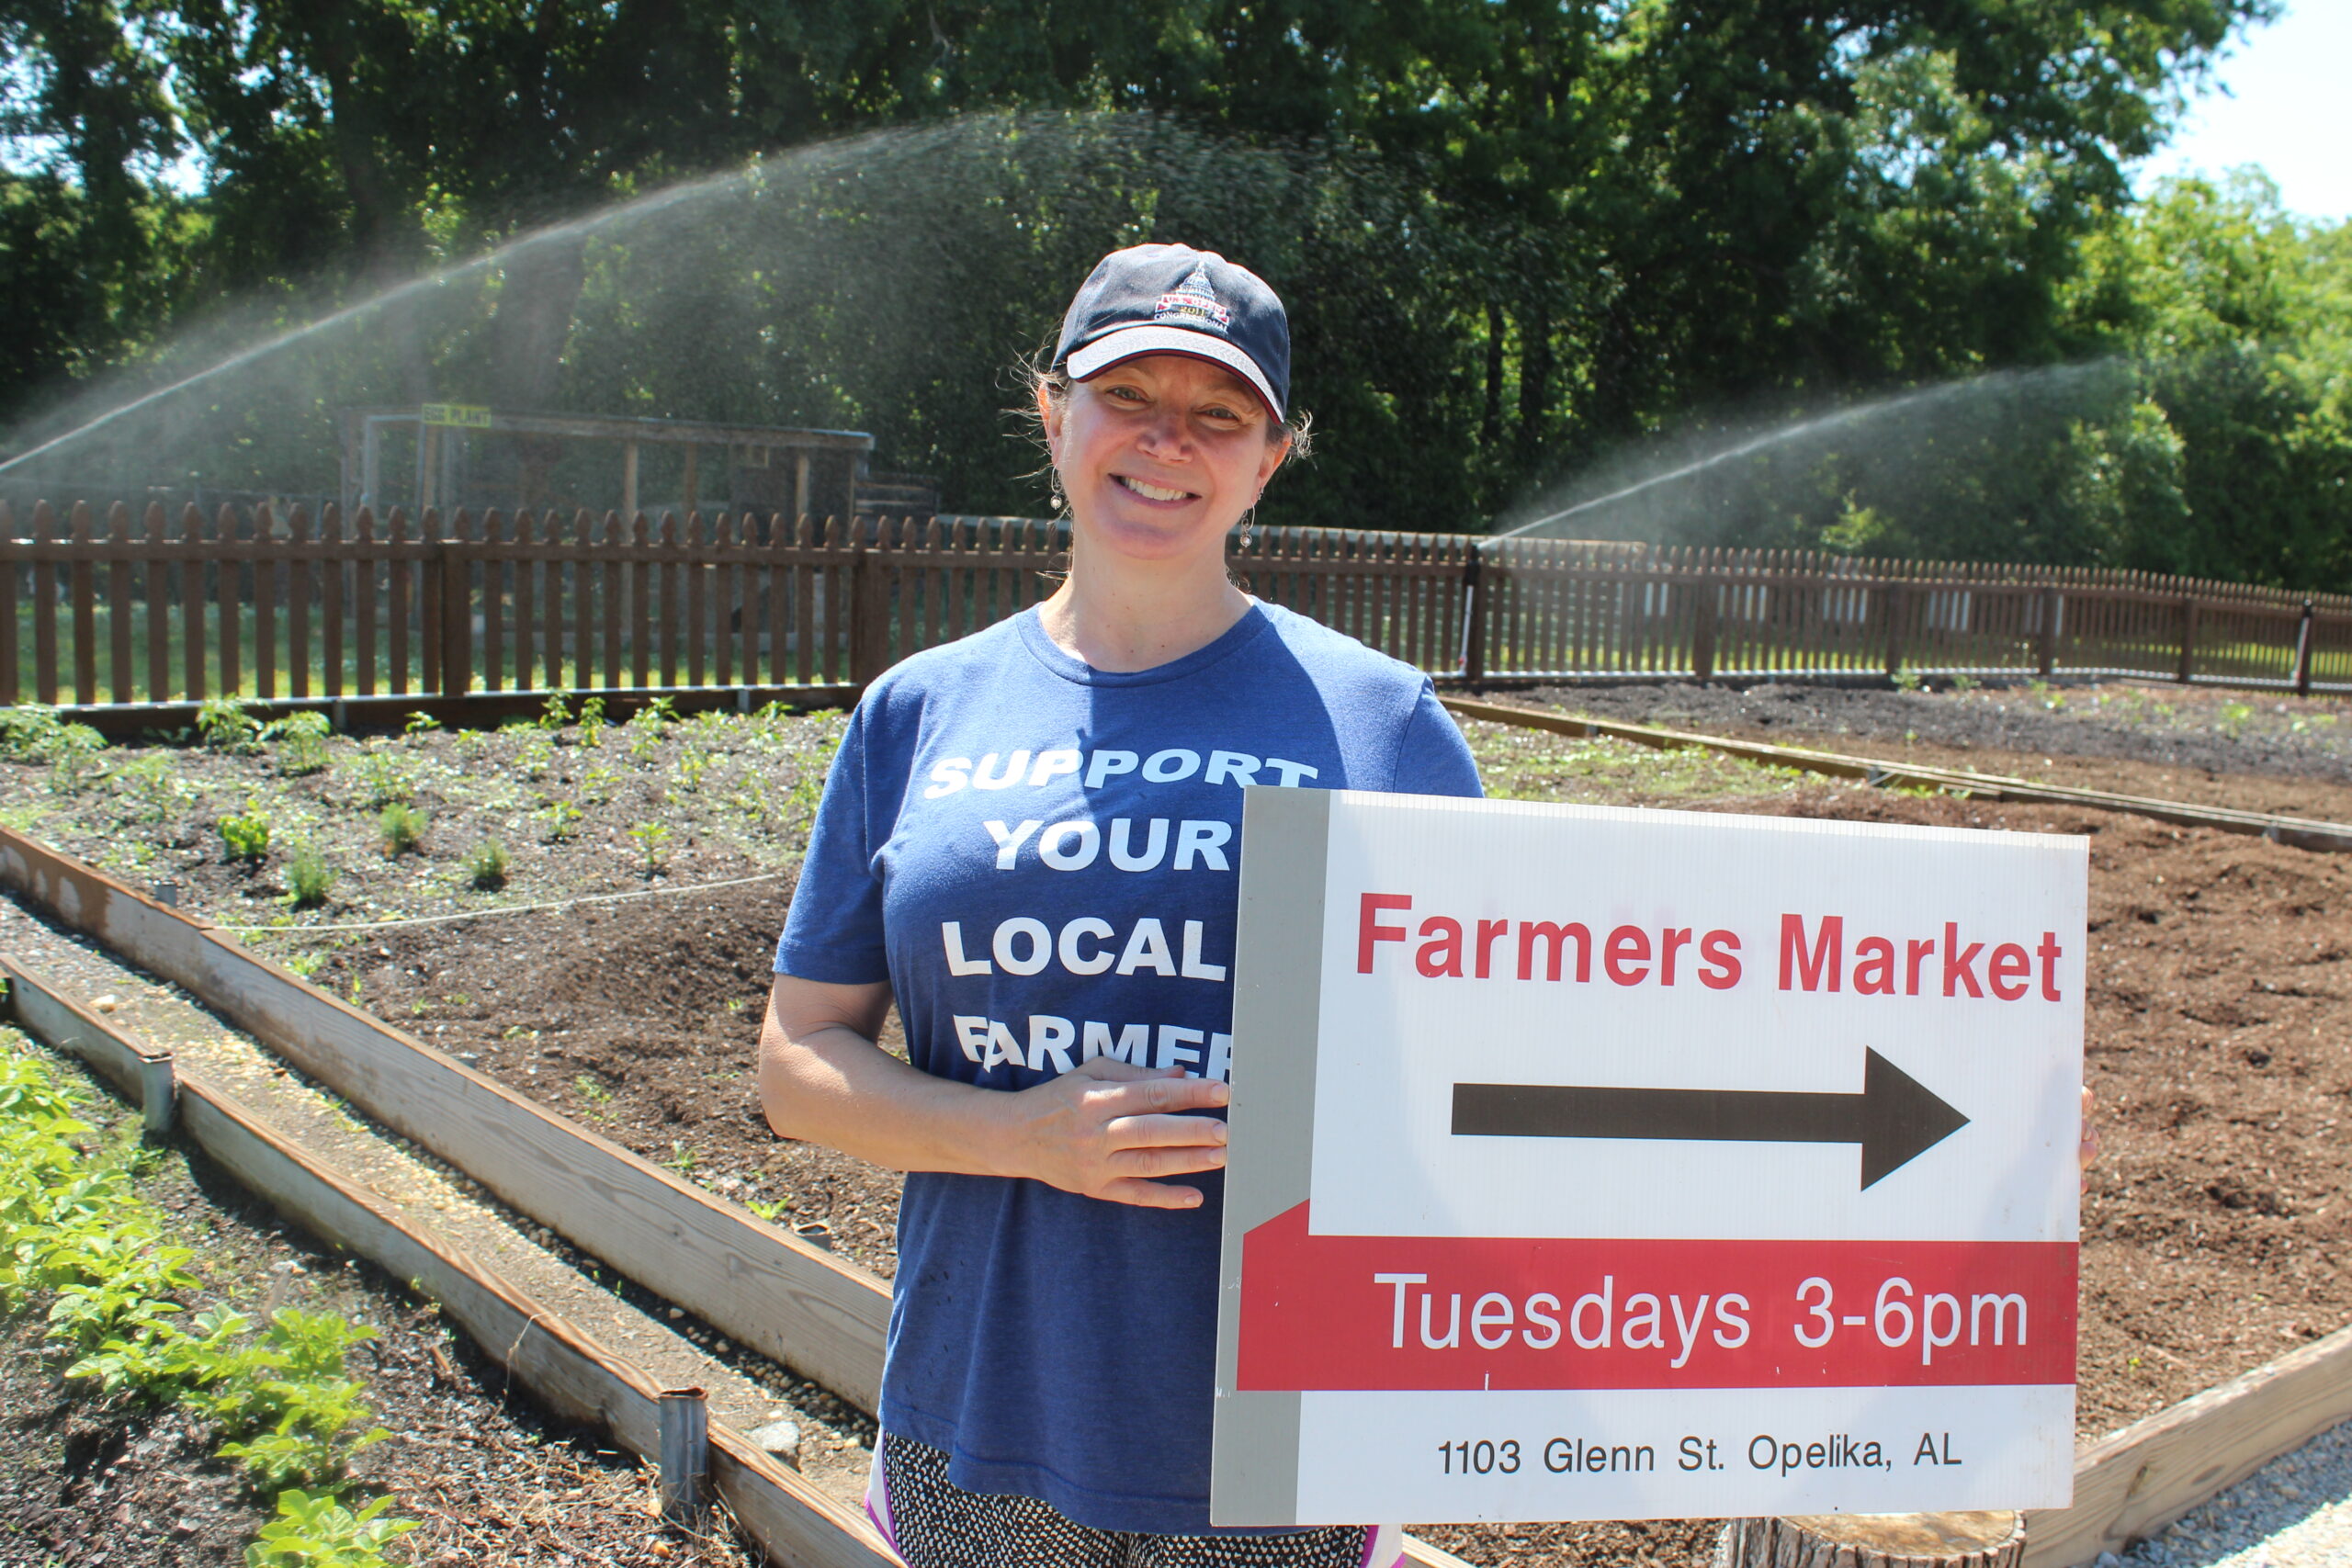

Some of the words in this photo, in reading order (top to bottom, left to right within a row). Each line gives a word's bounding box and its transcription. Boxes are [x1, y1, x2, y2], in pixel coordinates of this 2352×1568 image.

[1154, 311, 1228, 333] CONGRESSIONAL
[1180, 306, 1206, 317] 2011
[924, 747, 1319, 800] SUPPORT
[983, 818, 1232, 872] YOUR
[942, 917, 1227, 981] LOCAL
[1358, 894, 1742, 989] Farmers
[1779, 913, 2064, 1001] Market
[1374, 1273, 1750, 1369] Tuesdays
[1793, 1277, 2028, 1366] 3-6pm
[1438, 1439, 1521, 1474] 1103
[1544, 1438, 1655, 1473] Glenn
[1678, 1436, 1724, 1472] St.
[1747, 1435, 1893, 1477] Opelika,
[1913, 1433, 1962, 1466] AL
